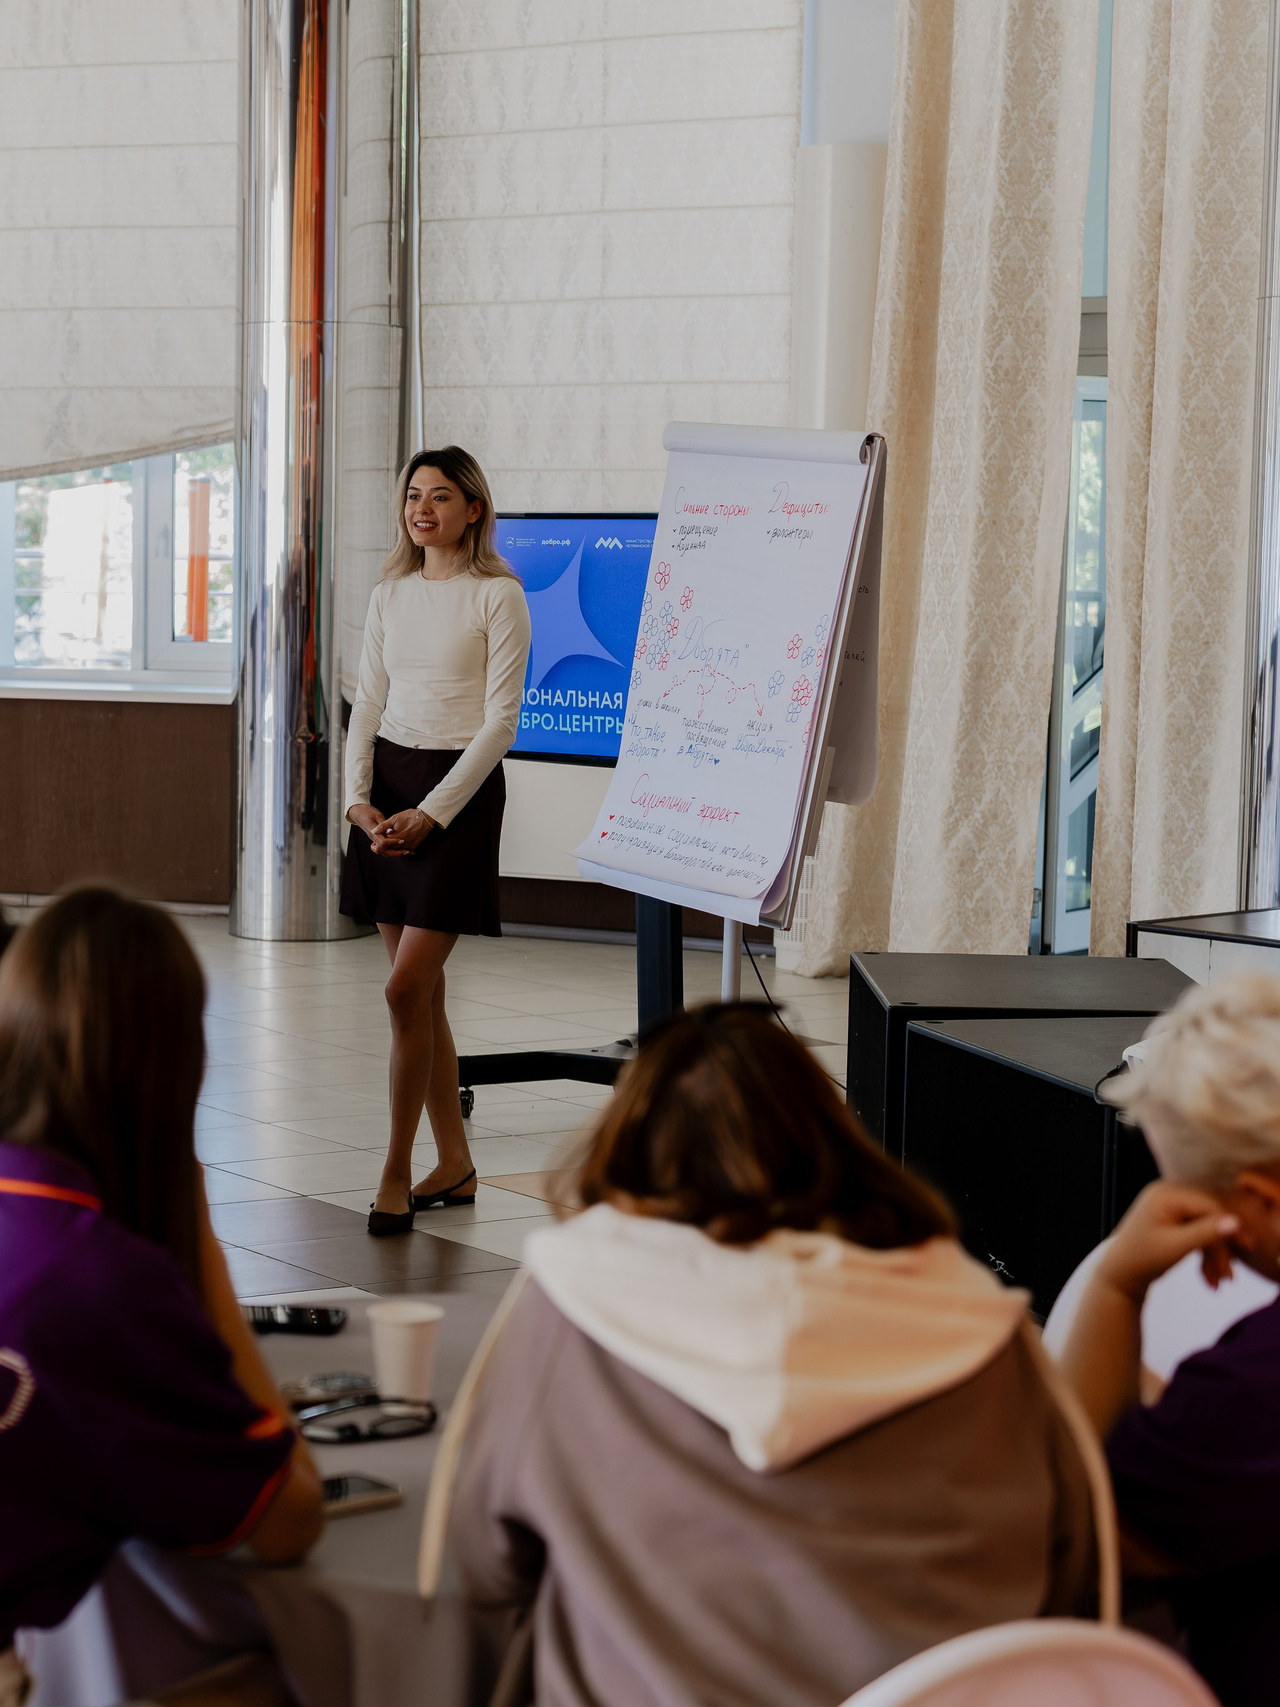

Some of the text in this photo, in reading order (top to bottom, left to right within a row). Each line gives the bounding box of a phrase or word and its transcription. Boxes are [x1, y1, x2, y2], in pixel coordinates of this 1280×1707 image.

[675, 486, 710, 514] Сильные
[768, 481, 830, 522] Дефициты:
[697, 804, 740, 828] эффект
